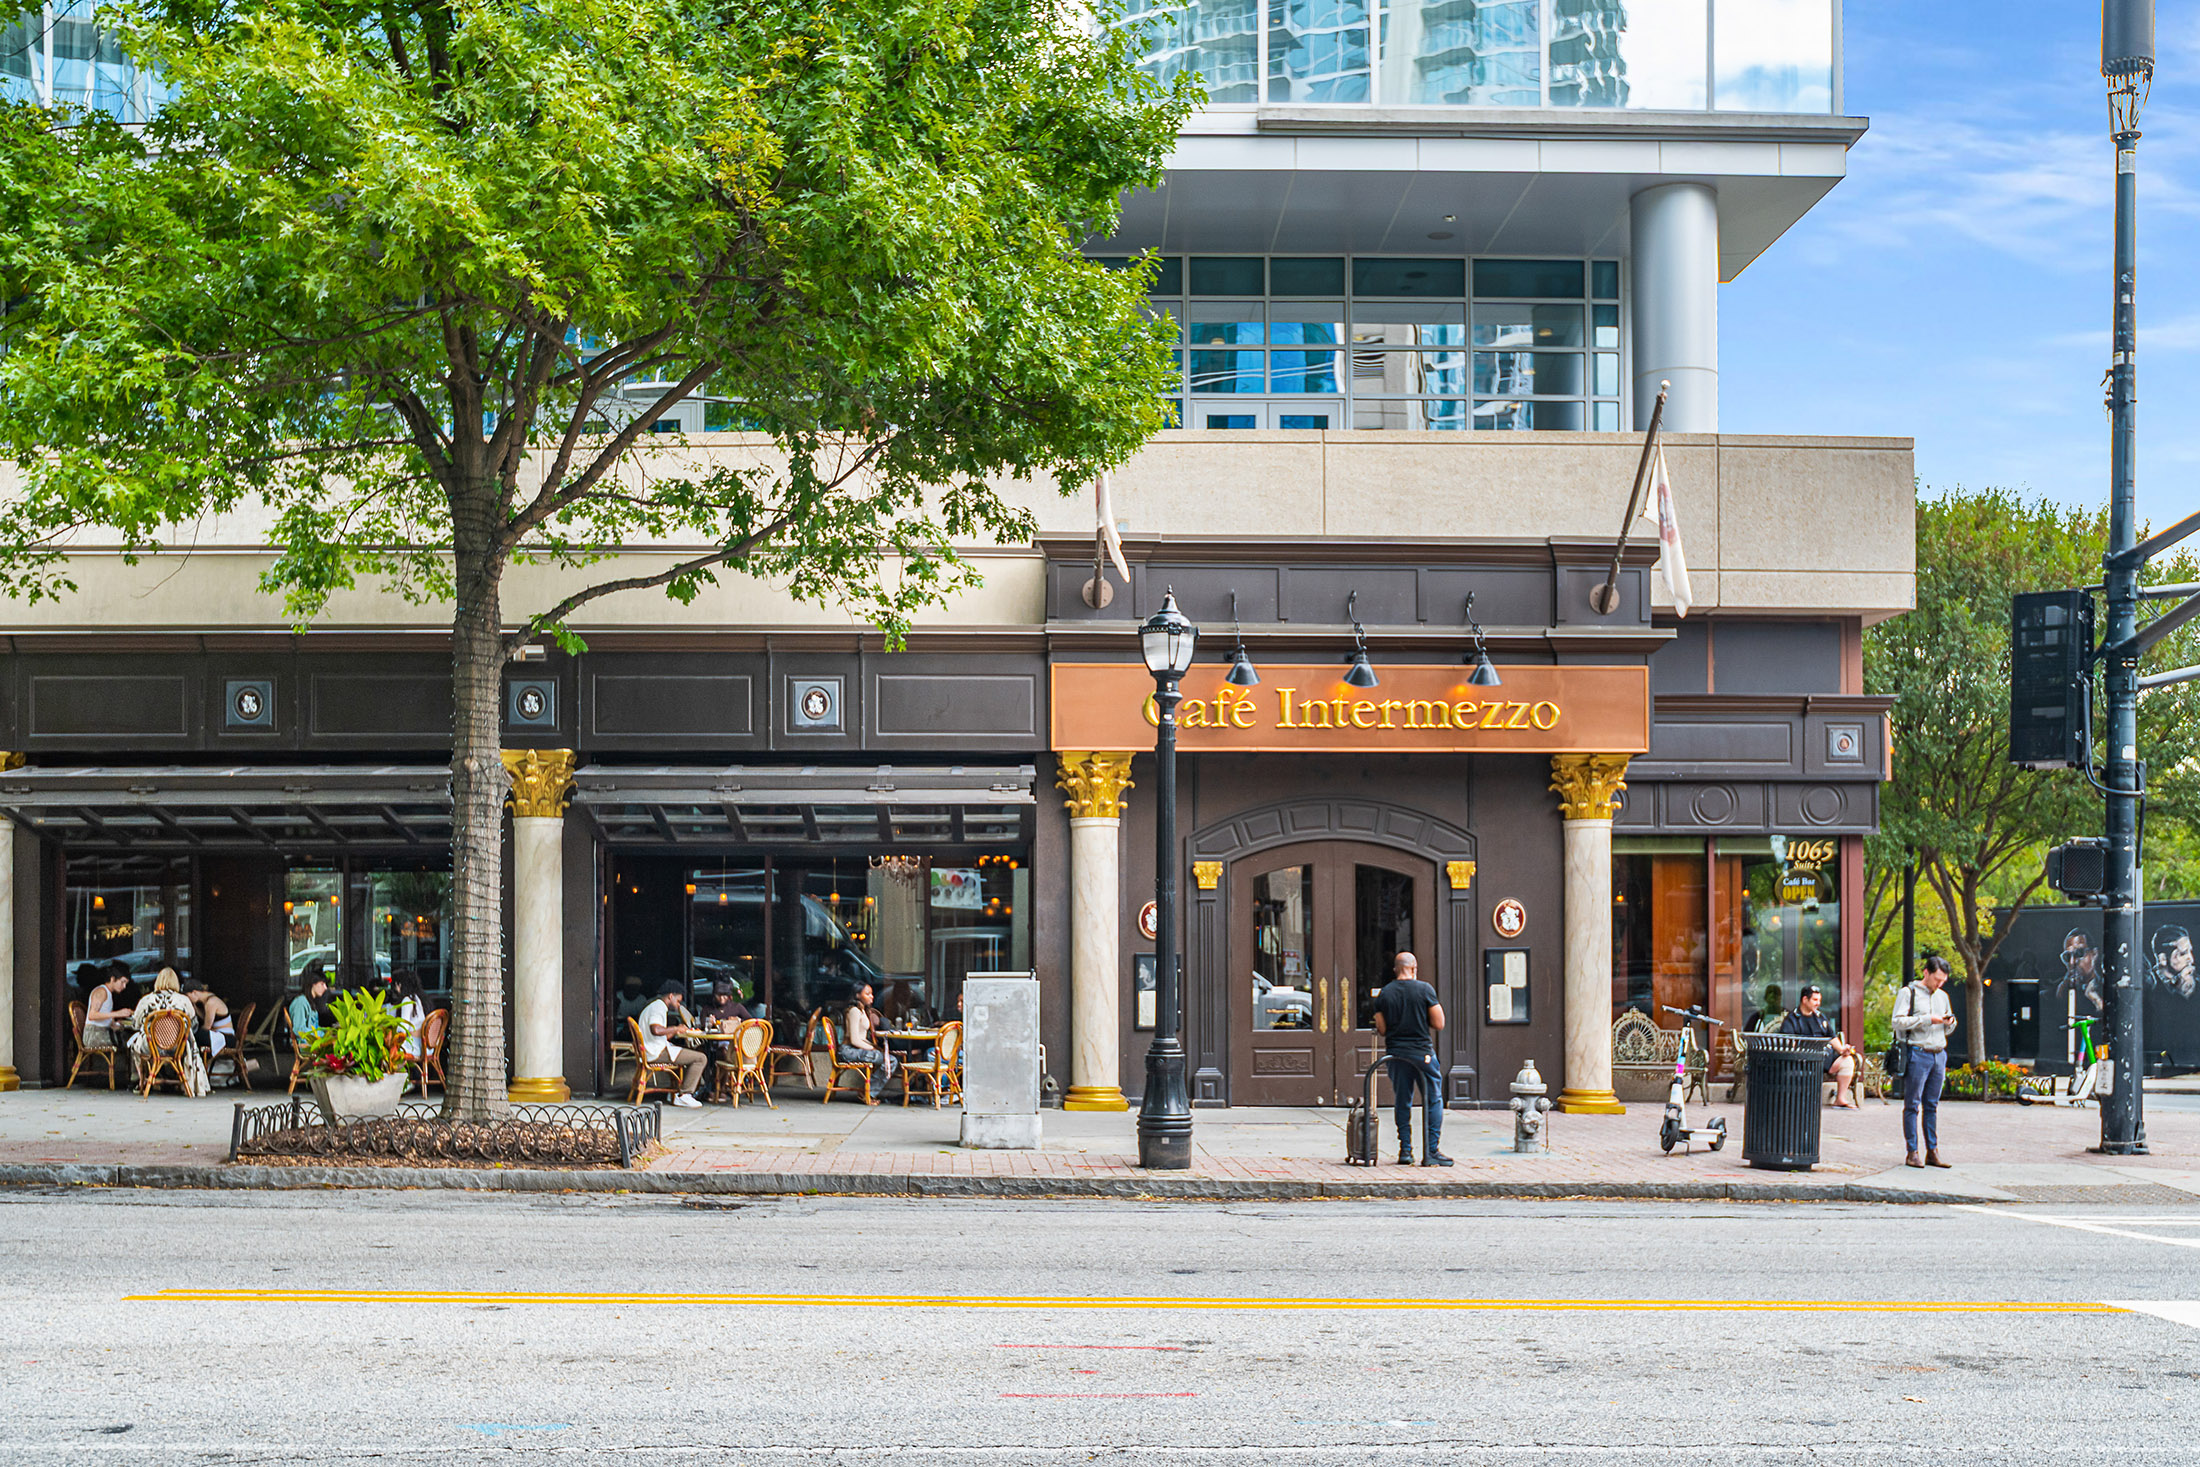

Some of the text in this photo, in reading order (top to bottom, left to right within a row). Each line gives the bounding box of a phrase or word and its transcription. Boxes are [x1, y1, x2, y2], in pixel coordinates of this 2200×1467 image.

[1274, 687, 1562, 731] Intermezzo
[1785, 839, 1834, 862] 1065
[1793, 860, 1822, 870] Suite 2
[1801, 877, 1816, 886] Bar
[1782, 885, 1816, 901] OPEN
